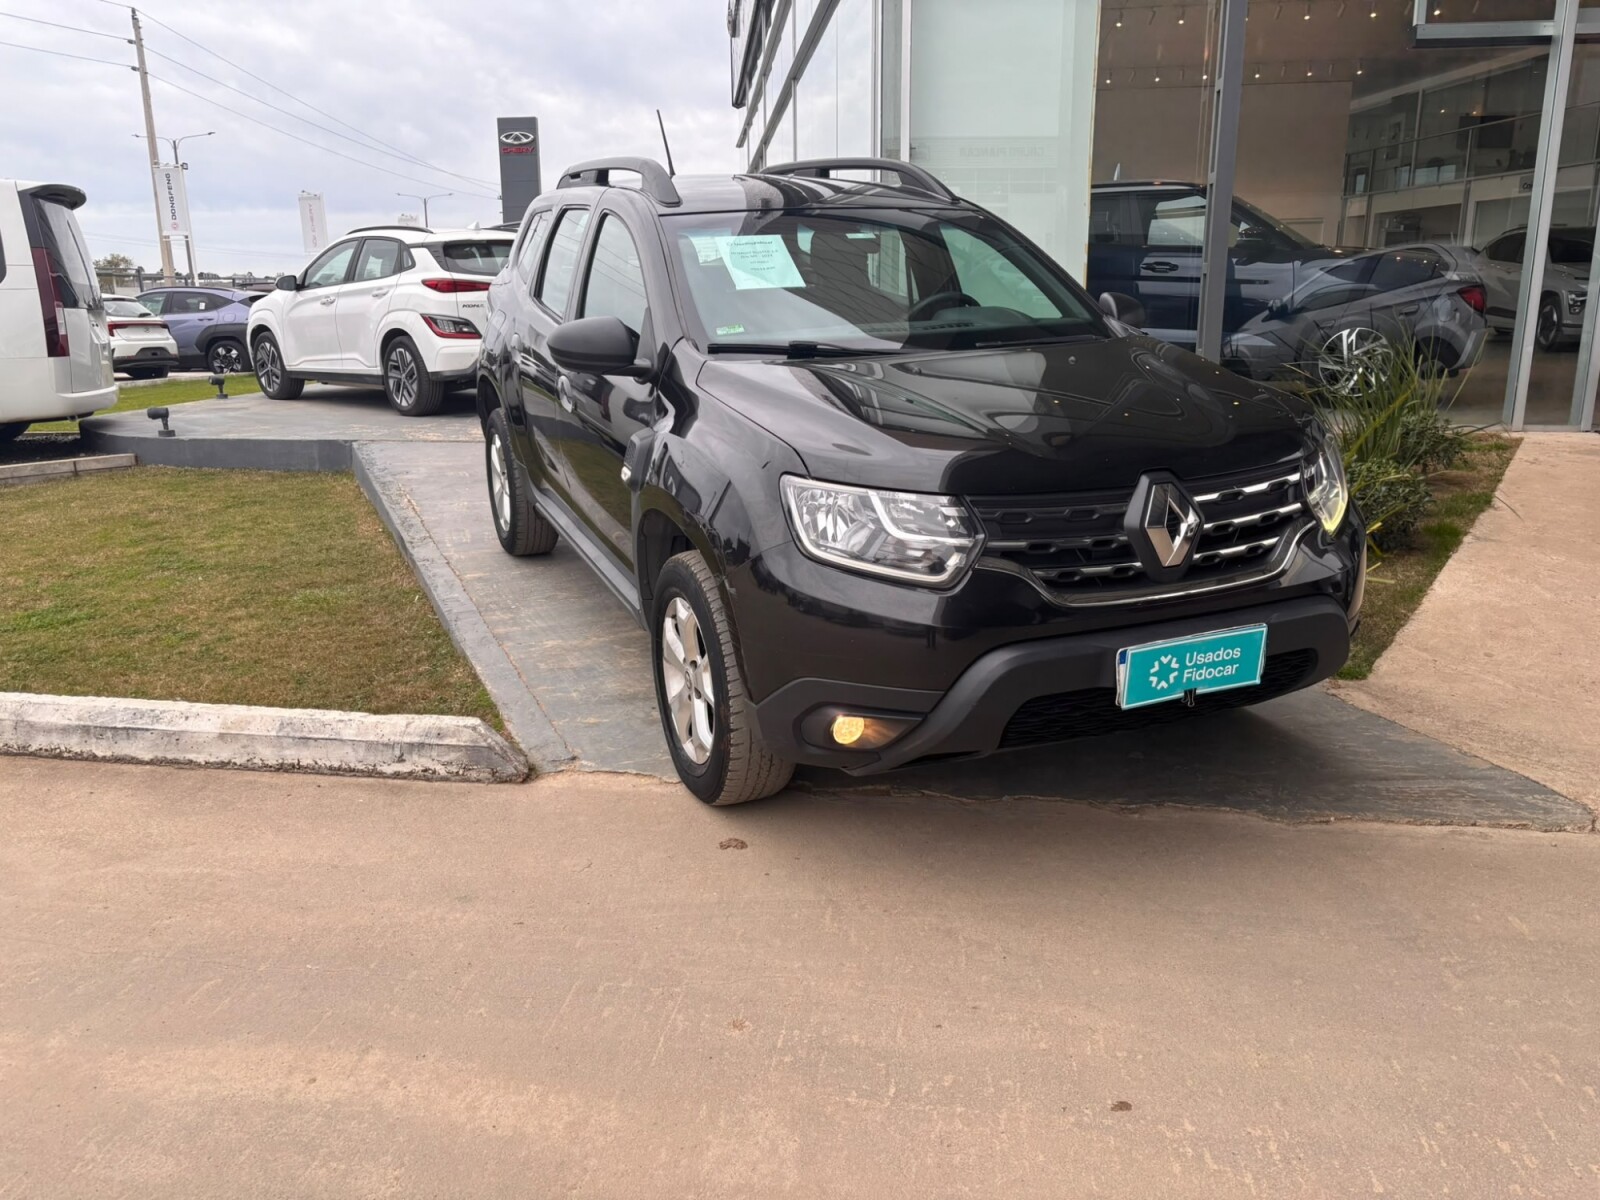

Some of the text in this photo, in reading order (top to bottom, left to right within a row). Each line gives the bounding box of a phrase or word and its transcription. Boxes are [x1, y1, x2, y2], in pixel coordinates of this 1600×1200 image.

[165, 172, 177, 221] DONGFENG
[1185, 647, 1242, 667] Usados
[1183, 663, 1240, 683] Fidocar
